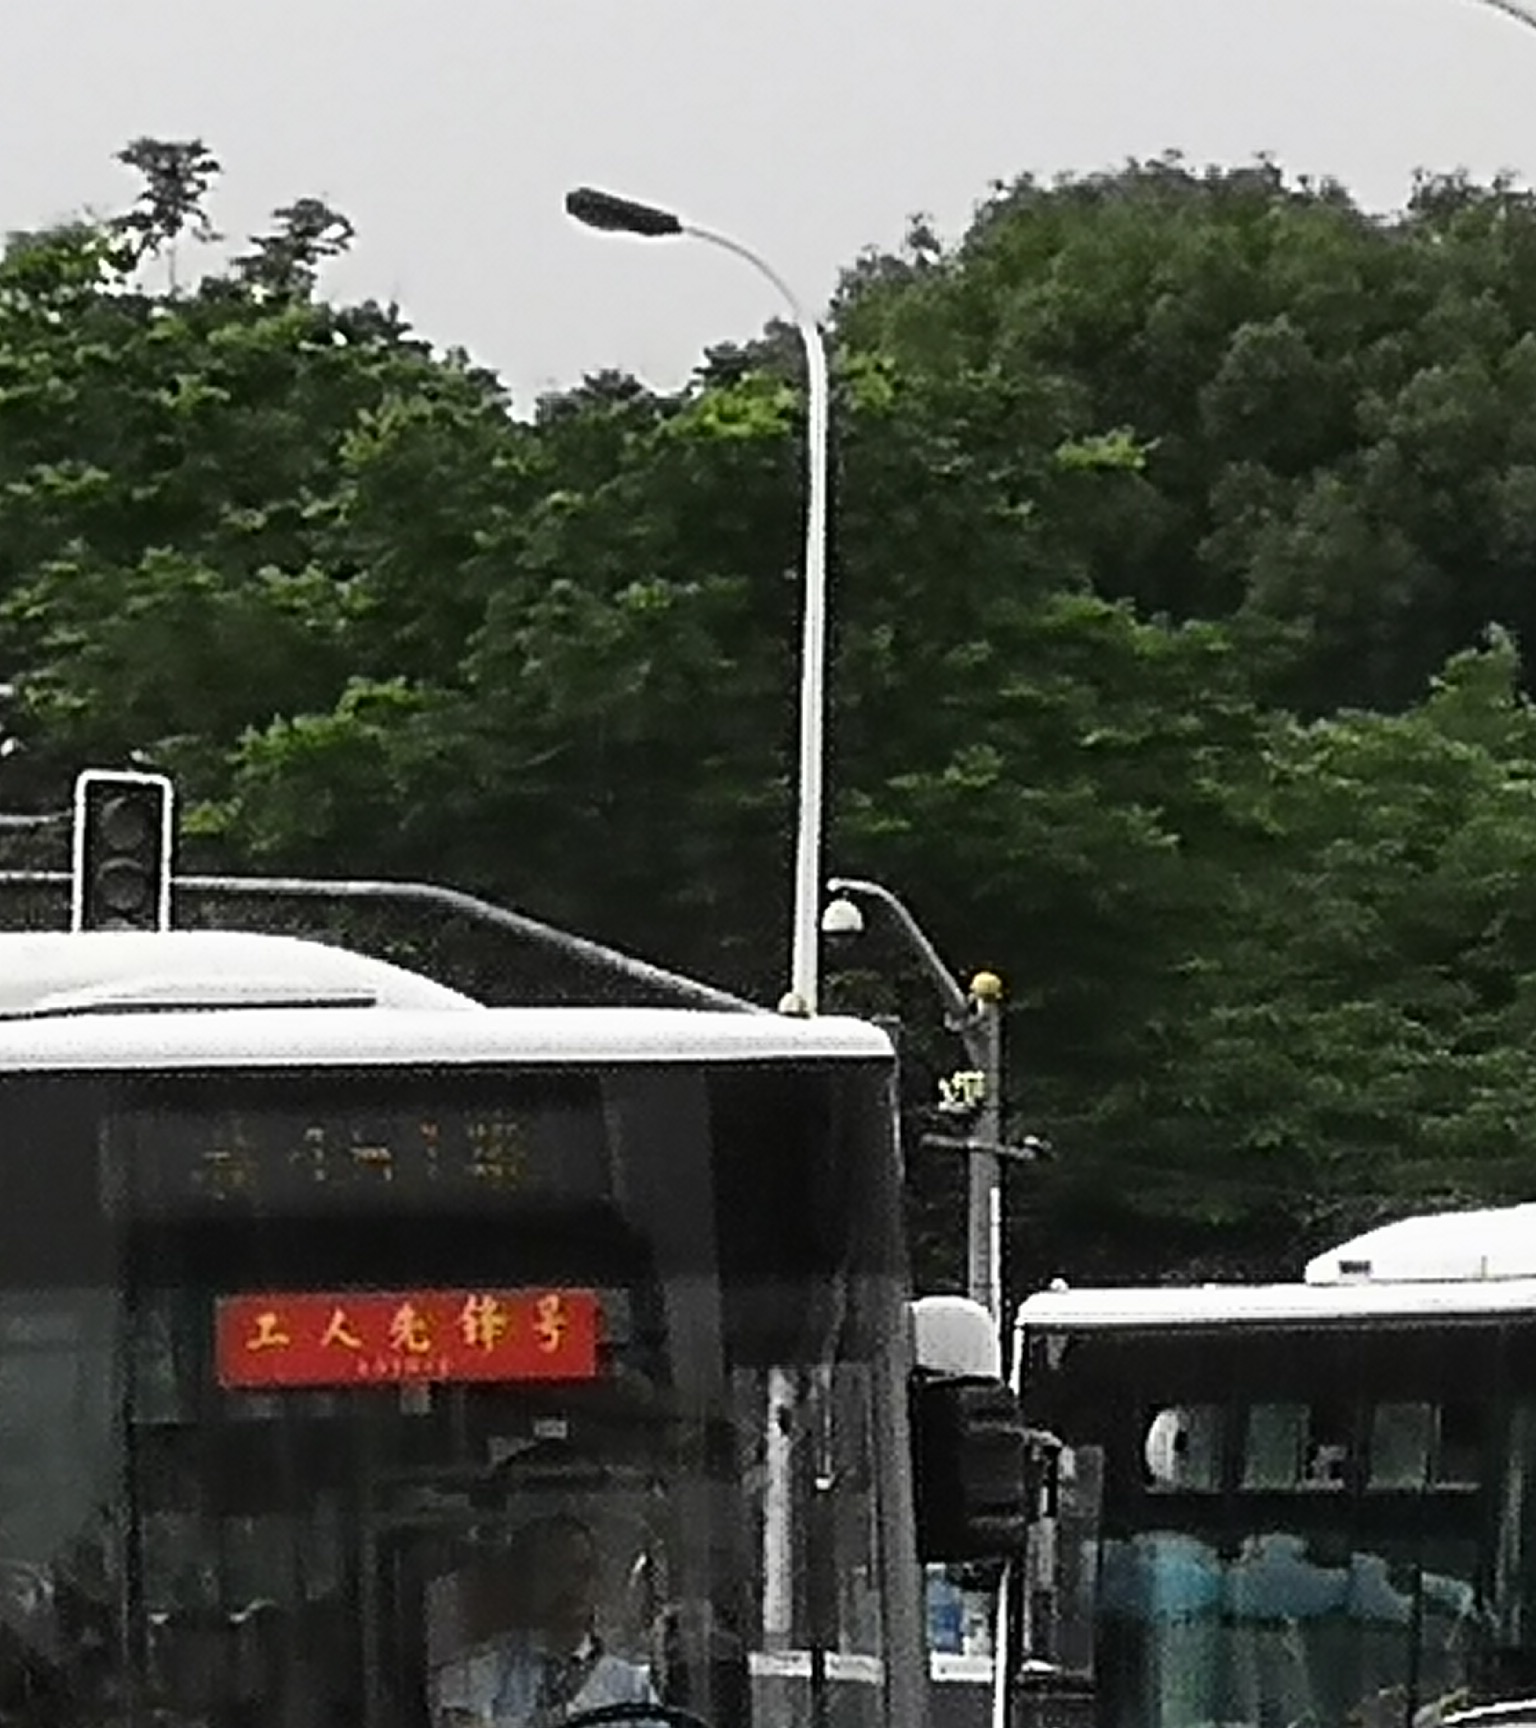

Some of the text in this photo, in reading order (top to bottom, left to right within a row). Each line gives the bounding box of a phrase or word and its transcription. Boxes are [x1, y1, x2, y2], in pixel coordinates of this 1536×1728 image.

[245, 1293, 567, 1355] 工人先锋号
